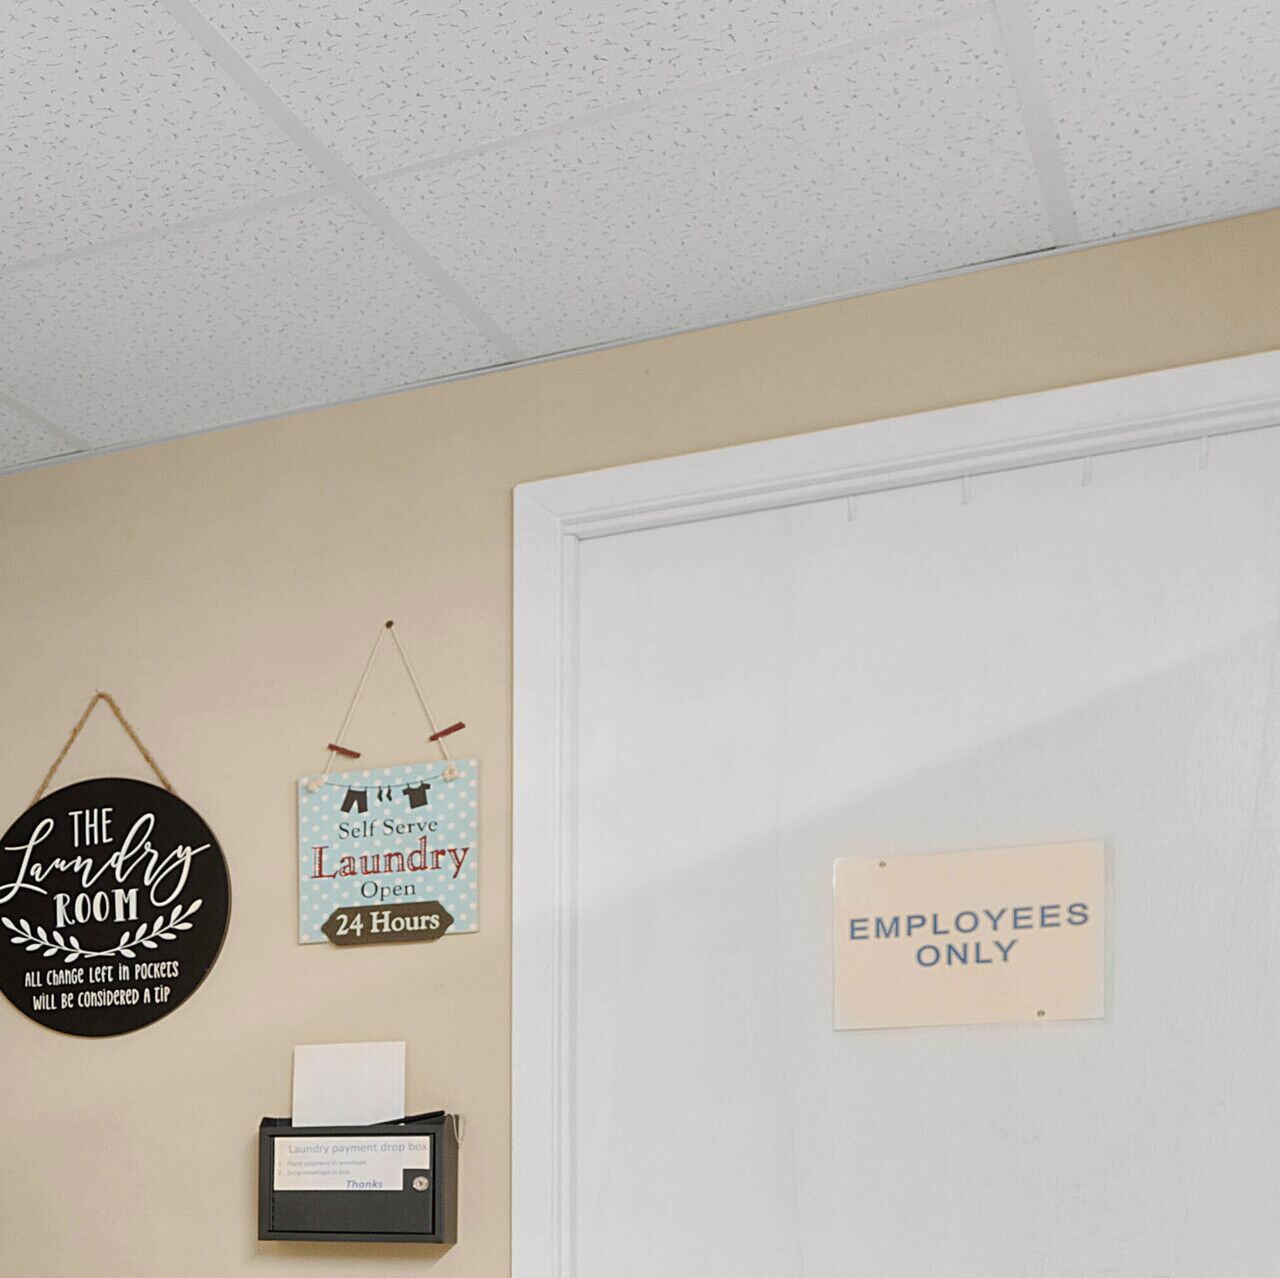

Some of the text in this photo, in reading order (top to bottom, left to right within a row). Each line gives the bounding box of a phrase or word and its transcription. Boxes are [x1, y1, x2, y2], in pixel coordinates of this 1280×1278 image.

[68, 807, 114, 848] THE
[338, 818, 439, 840] Self Serve
[310, 835, 470, 879] Laundry
[360, 880, 416, 901] Open
[53, 888, 140, 928] ROOM
[335, 910, 441, 937] 24 Hours
[848, 901, 1090, 941] EMPLOYEES
[915, 939, 1019, 968] ONLY
[24, 970, 42, 988] ALL
[143, 987, 152, 1003] A
[289, 1142, 428, 1154] Laundry payment drop box
[346, 1179, 384, 1189] Thanks
